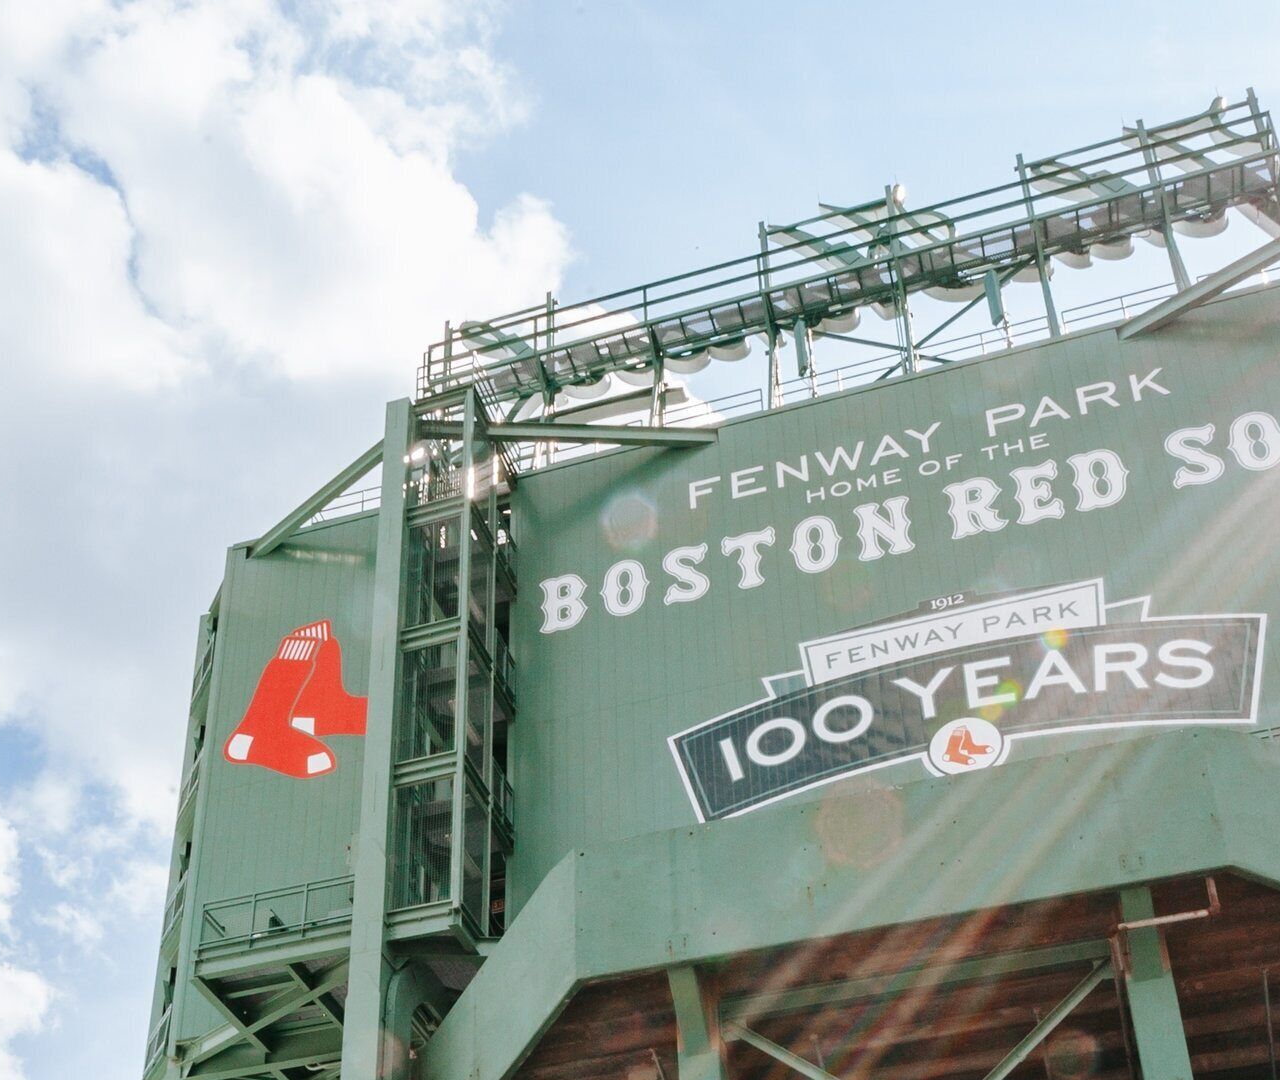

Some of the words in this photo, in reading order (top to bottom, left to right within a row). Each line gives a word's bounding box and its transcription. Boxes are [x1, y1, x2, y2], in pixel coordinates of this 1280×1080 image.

[688, 422, 943, 509] FENWAY
[985, 367, 1171, 437] PARK
[806, 468, 902, 504] HOME
[918, 453, 963, 476] OF
[980, 433, 1050, 461] THE
[539, 495, 916, 634] BOSTON
[942, 449, 1130, 540] RED
[825, 622, 965, 669] FENWAY
[982, 600, 1081, 632] PARK
[930, 594, 965, 610] 1912
[719, 694, 874, 783] 100
[891, 639, 1215, 719] YEARS
